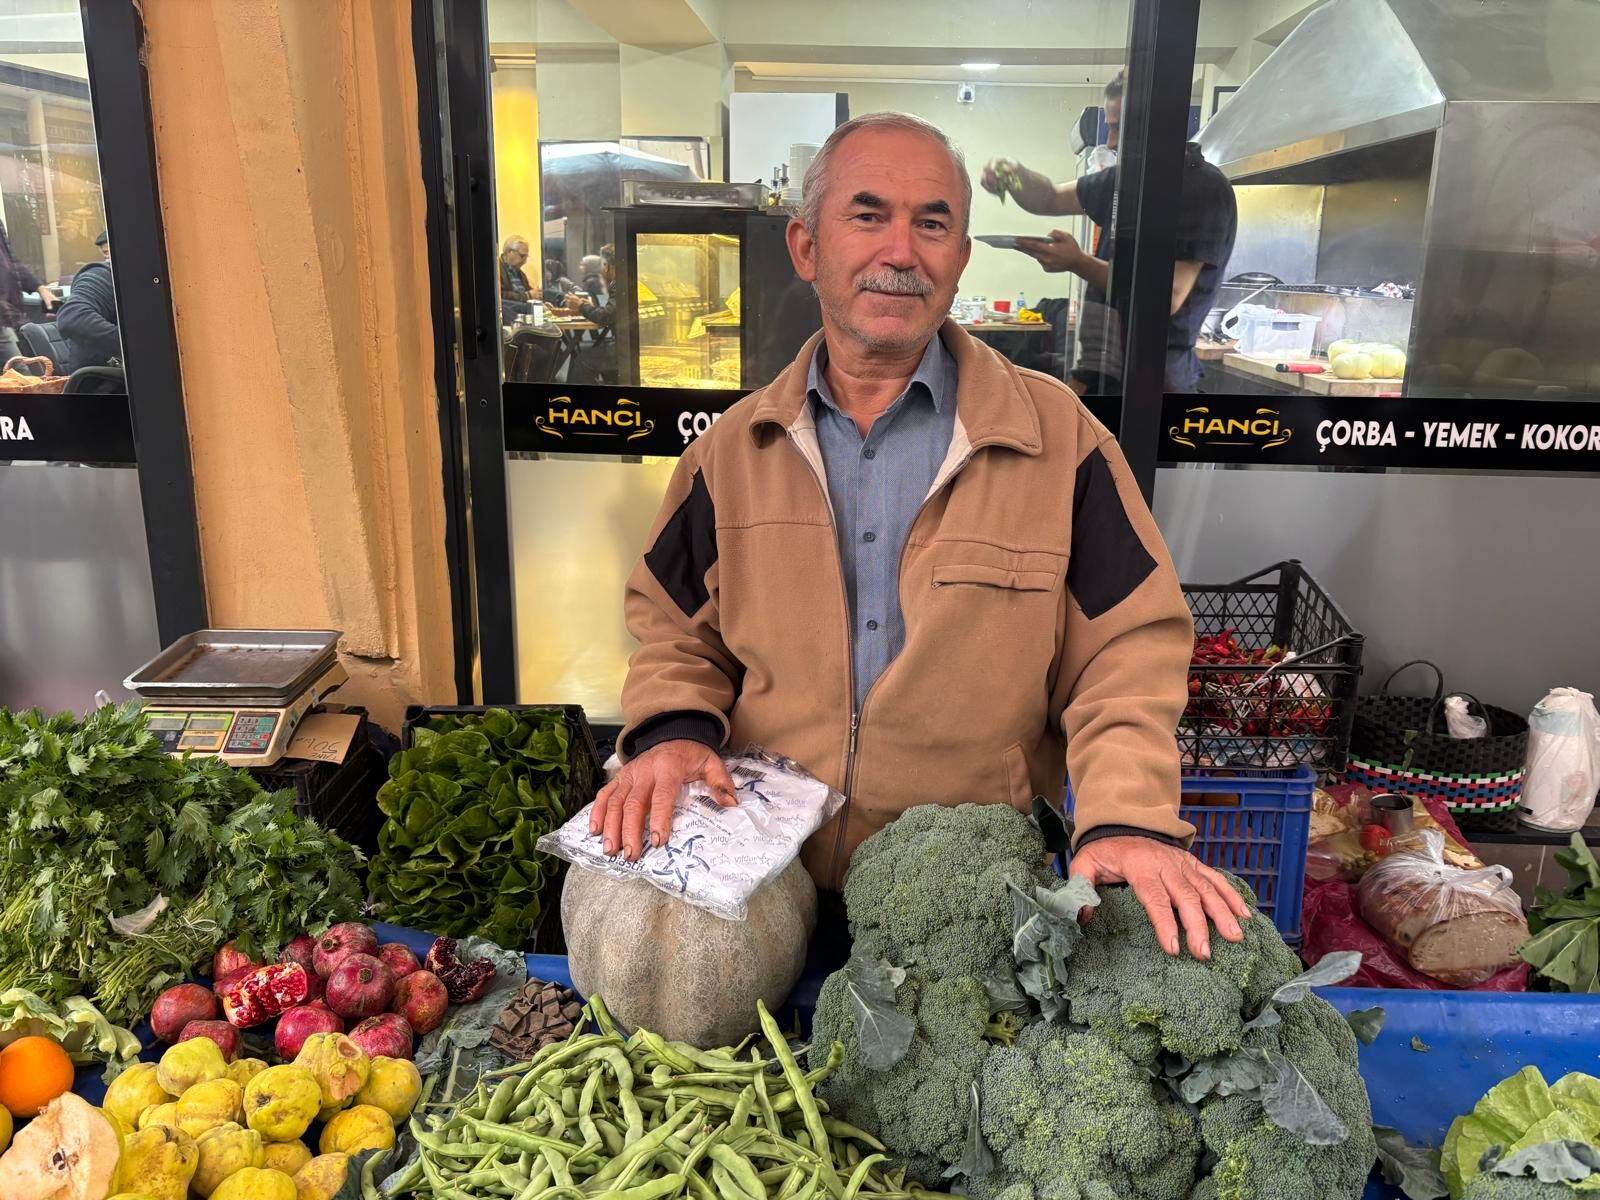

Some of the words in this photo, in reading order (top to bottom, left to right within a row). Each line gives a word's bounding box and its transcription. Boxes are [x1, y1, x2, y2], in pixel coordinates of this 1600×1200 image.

[0, 415, 35, 441] RA
[548, 408, 641, 427] HANCI
[1183, 418, 1279, 436] HANCI
[1315, 419, 1397, 453] ÇORBA
[1423, 421, 1500, 449] YEMEK
